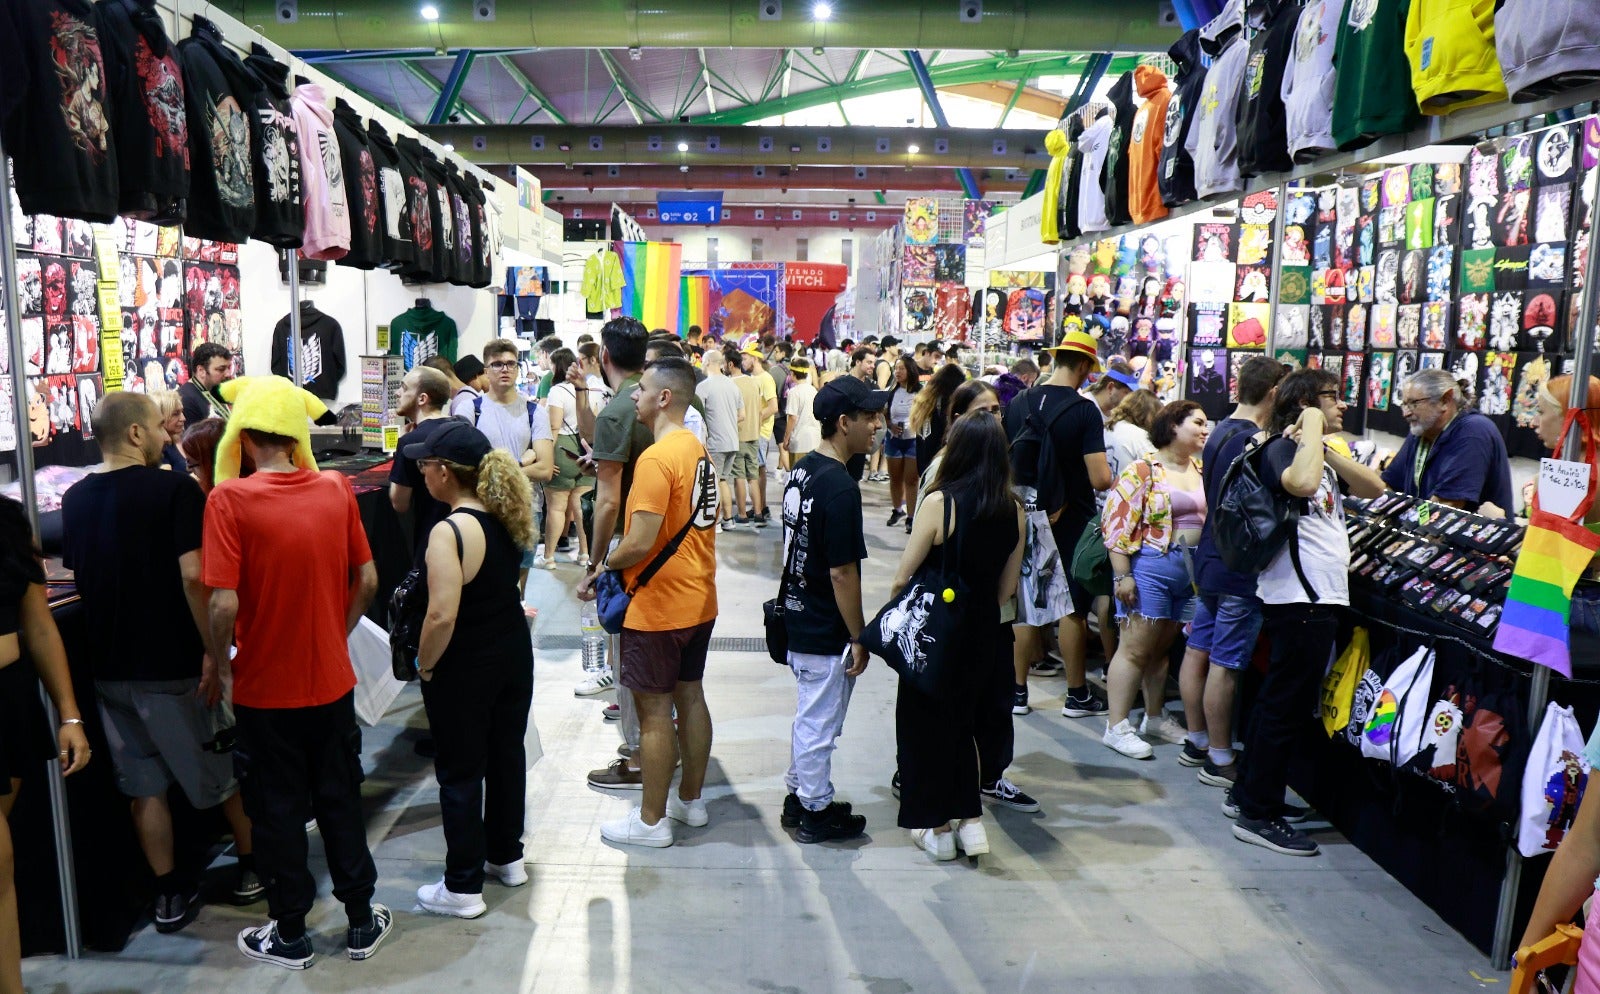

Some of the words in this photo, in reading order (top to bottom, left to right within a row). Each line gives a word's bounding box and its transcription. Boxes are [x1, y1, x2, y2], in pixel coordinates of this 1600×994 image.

[692, 212, 699, 222] 2
[707, 206, 715, 221] 1
[1193, 336, 1223, 345] HAPPY
[1419, 504, 1428, 518] 10
